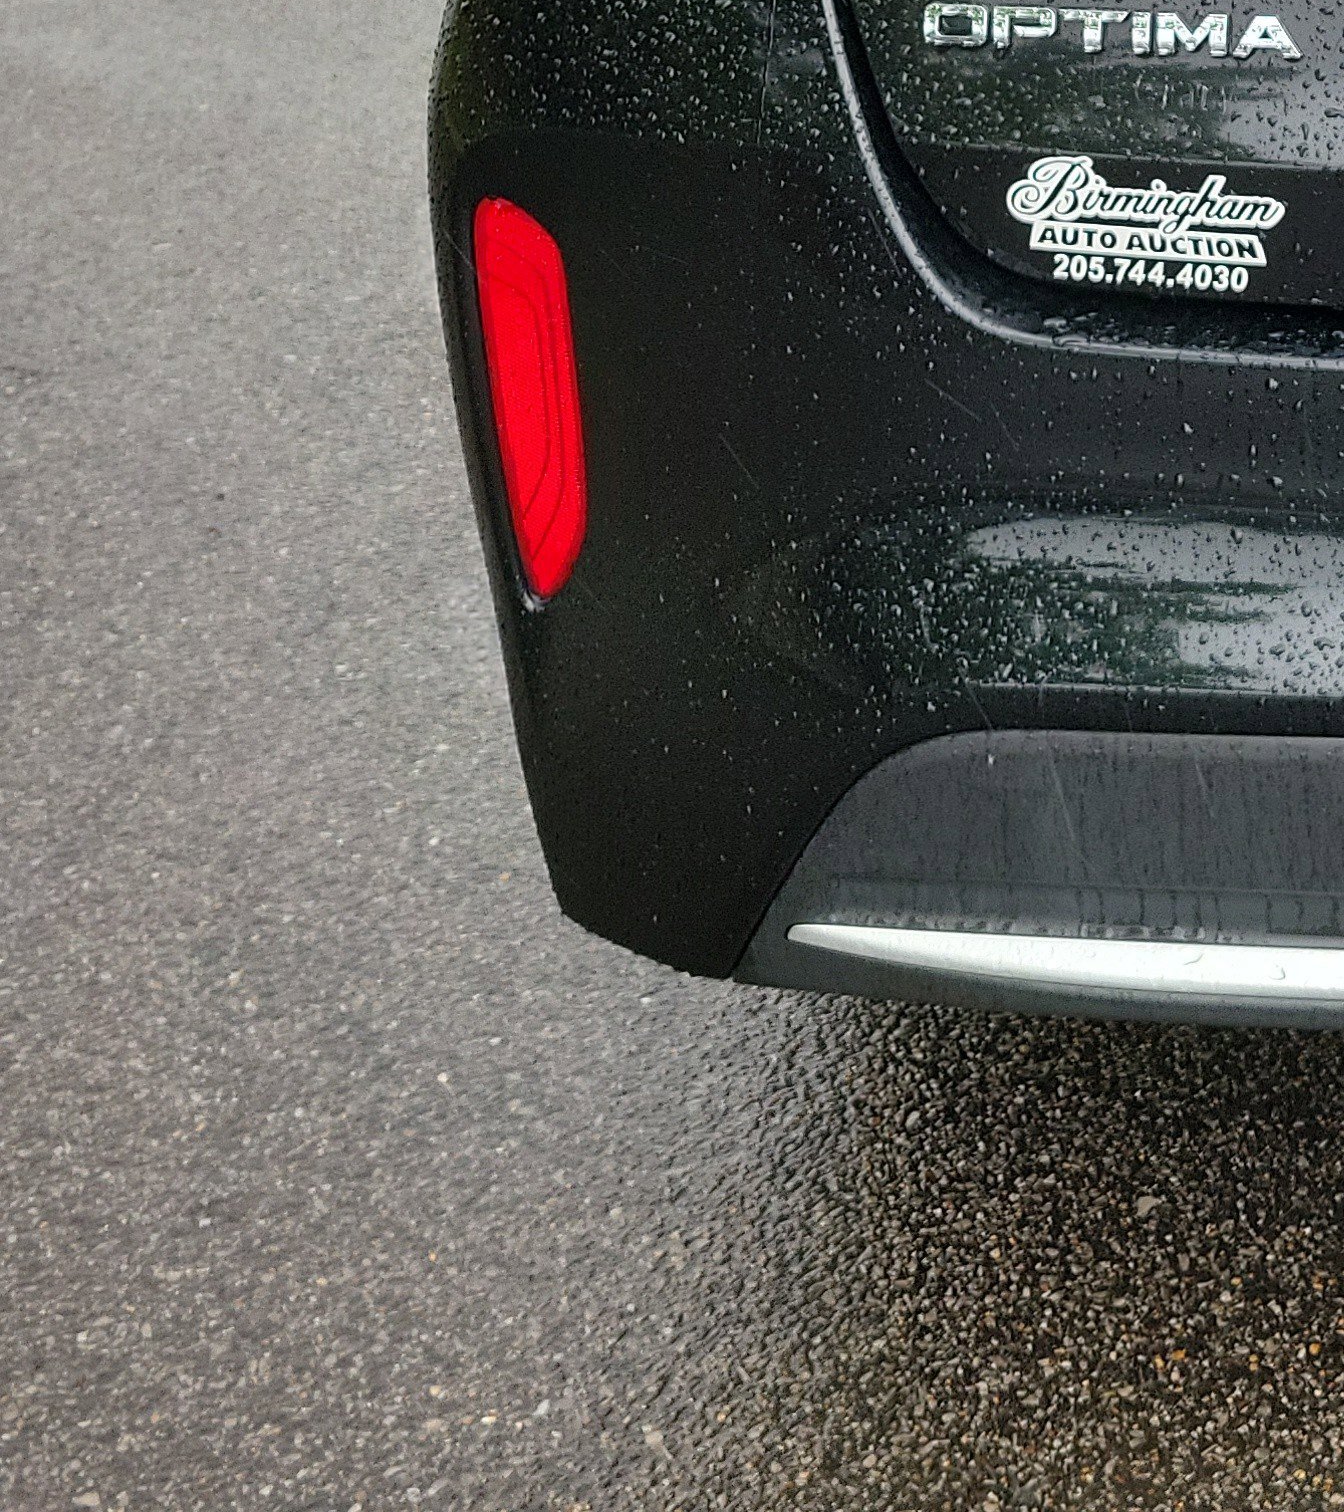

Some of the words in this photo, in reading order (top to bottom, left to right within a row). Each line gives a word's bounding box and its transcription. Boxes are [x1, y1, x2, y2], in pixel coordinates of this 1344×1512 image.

[923, 3, 1301, 59] OPTIMA
[1009, 160, 1282, 234] Birmingham
[1037, 224, 1118, 250] AUTO
[1126, 232, 1260, 259] AUCTION
[1053, 253, 1249, 293] 205.744.4030
